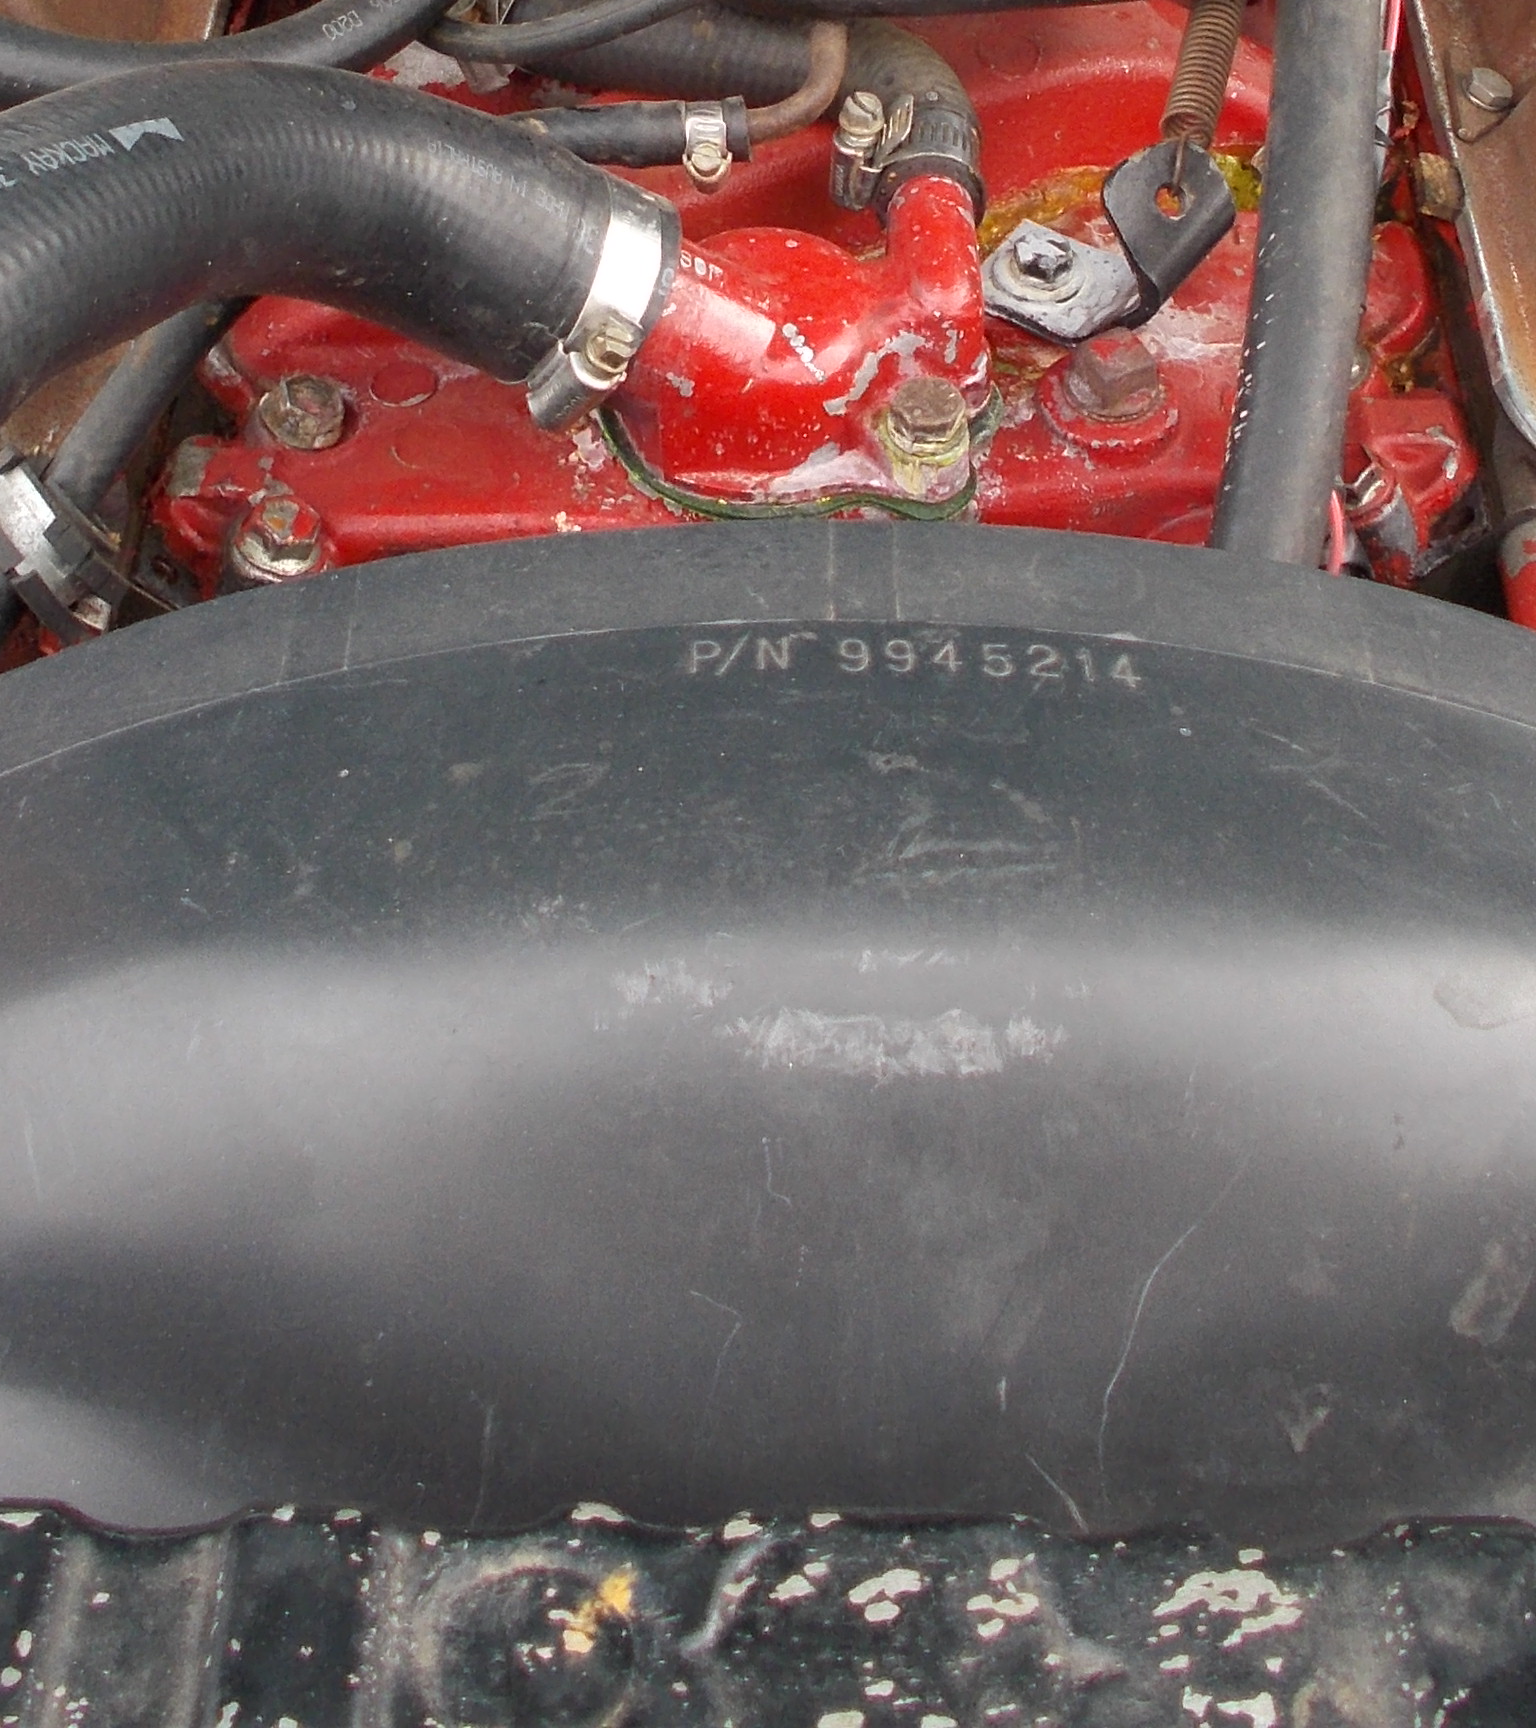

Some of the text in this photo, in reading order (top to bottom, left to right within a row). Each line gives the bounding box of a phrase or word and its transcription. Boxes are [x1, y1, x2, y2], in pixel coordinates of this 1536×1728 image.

[22, 132, 116, 177] MACKAY
[689, 633, 1143, 688] P/N 9945214
